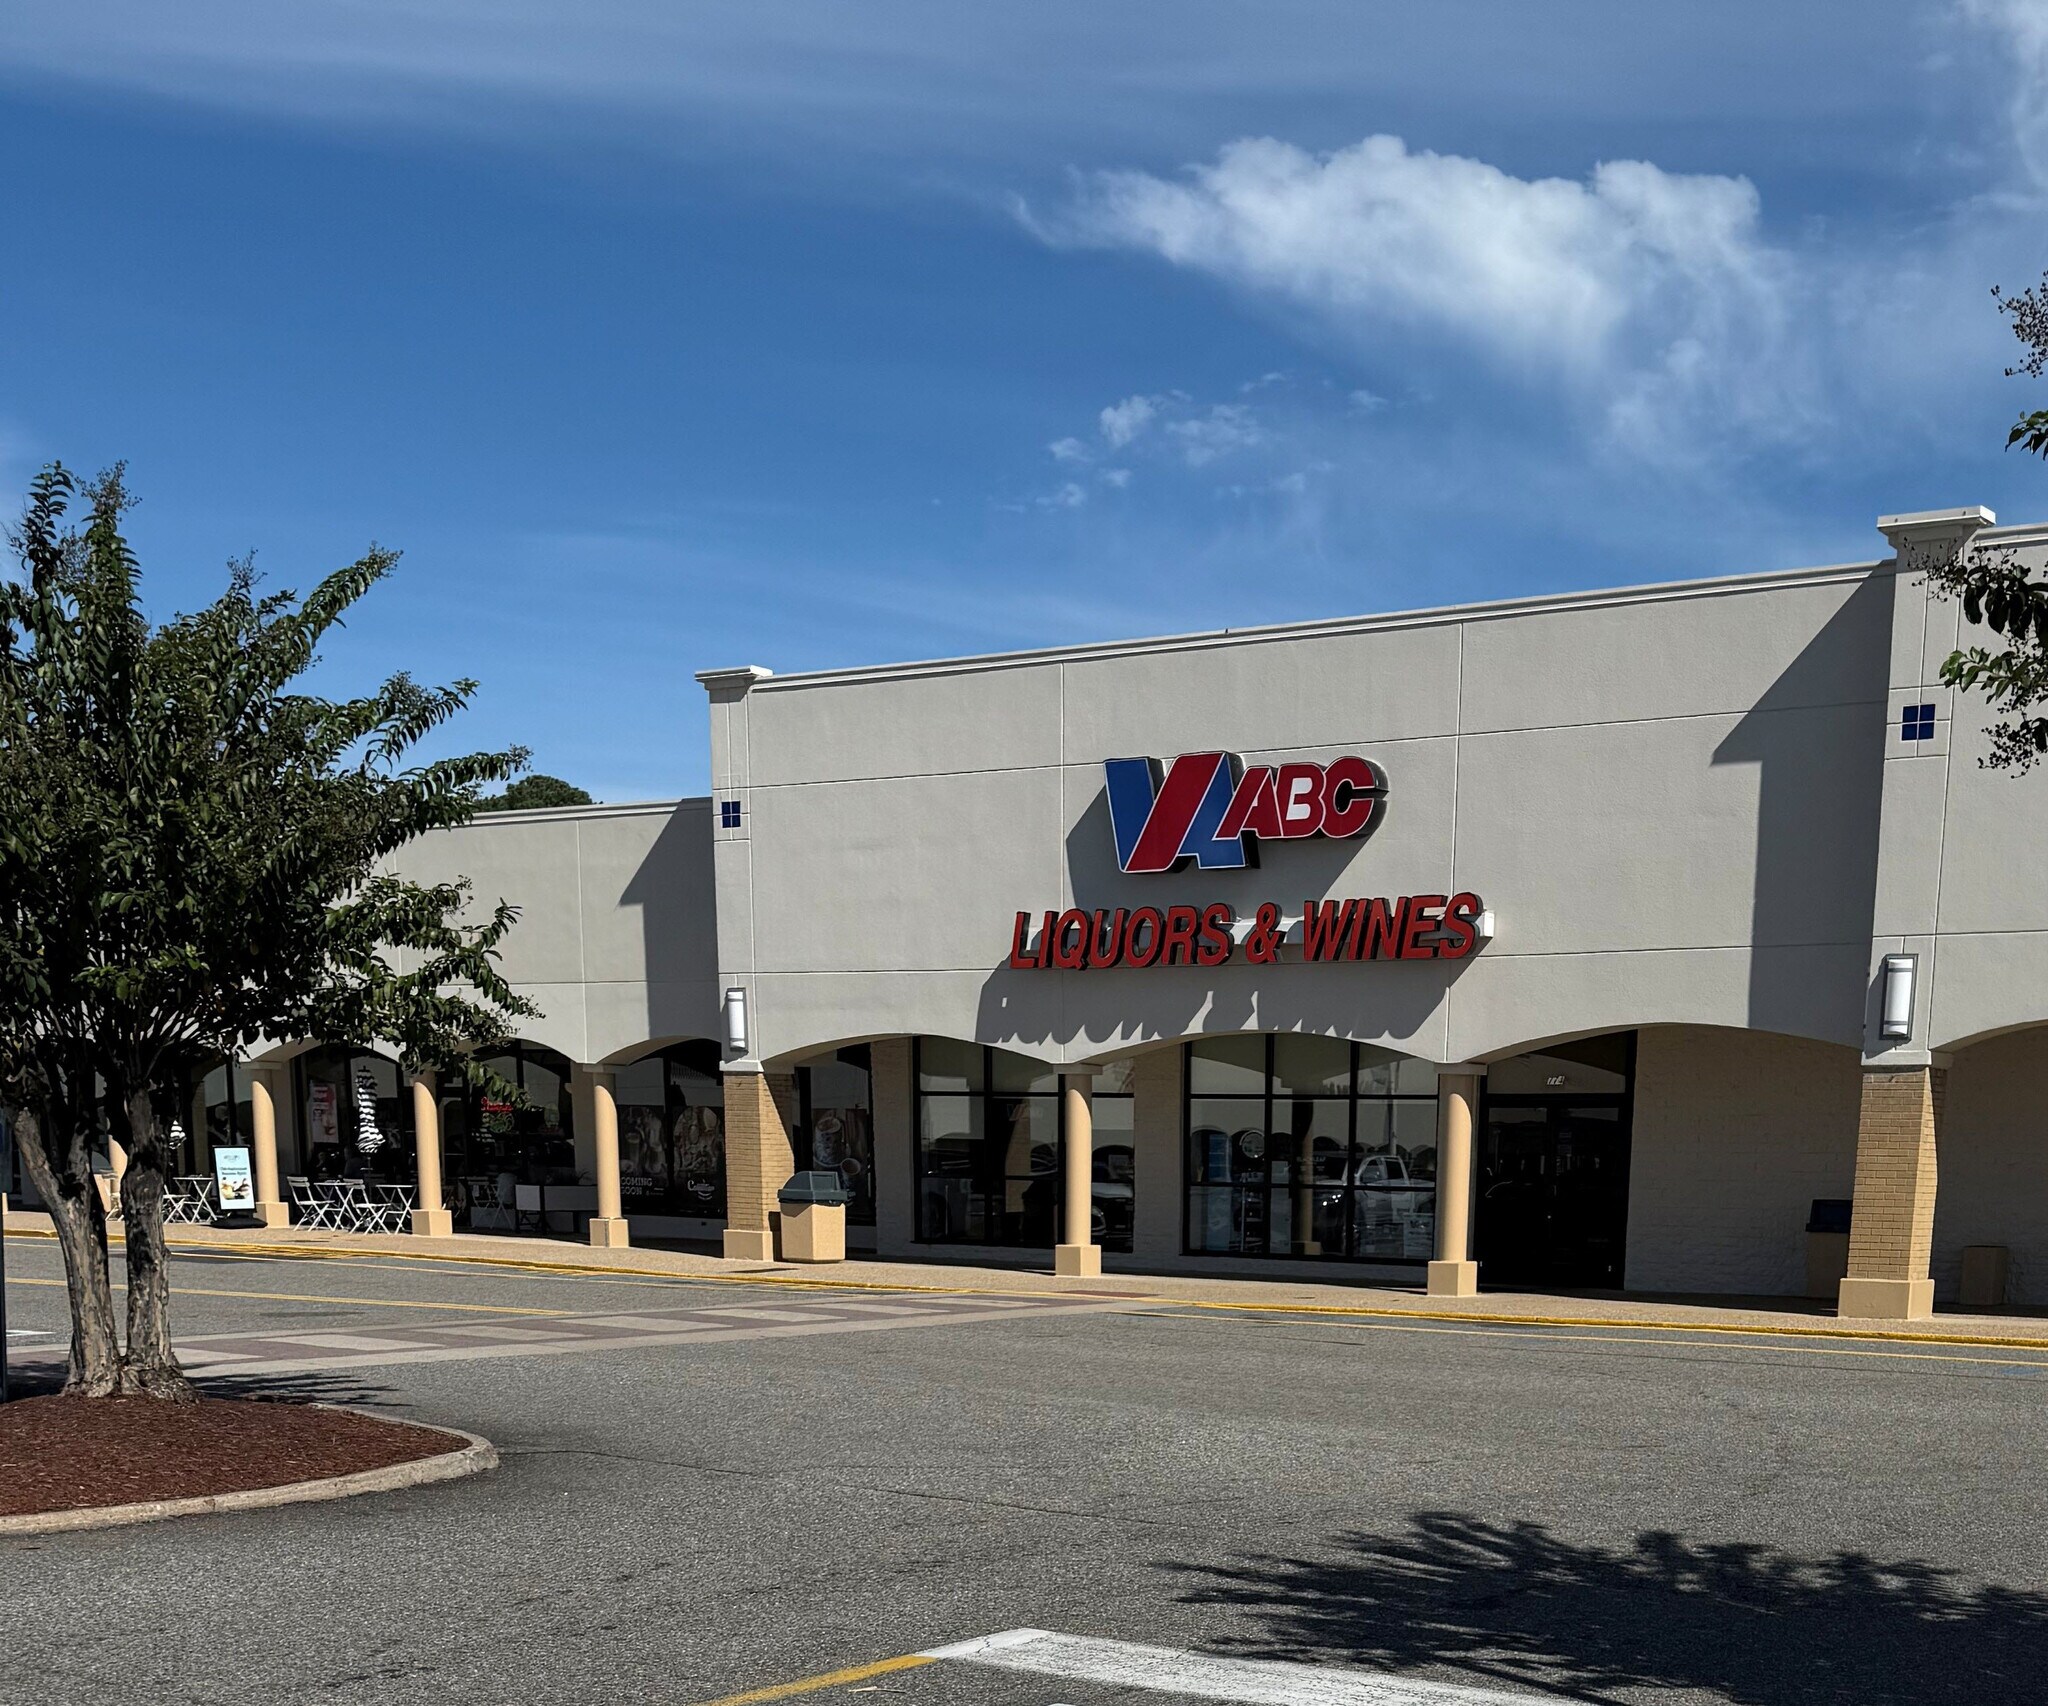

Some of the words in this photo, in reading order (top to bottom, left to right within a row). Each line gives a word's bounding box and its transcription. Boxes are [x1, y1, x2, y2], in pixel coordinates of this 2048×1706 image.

[1213, 755, 1382, 841] ABC
[1010, 904, 1234, 970] LIQUORS
[1246, 902, 1286, 964] &
[1303, 892, 1484, 961] WINES
